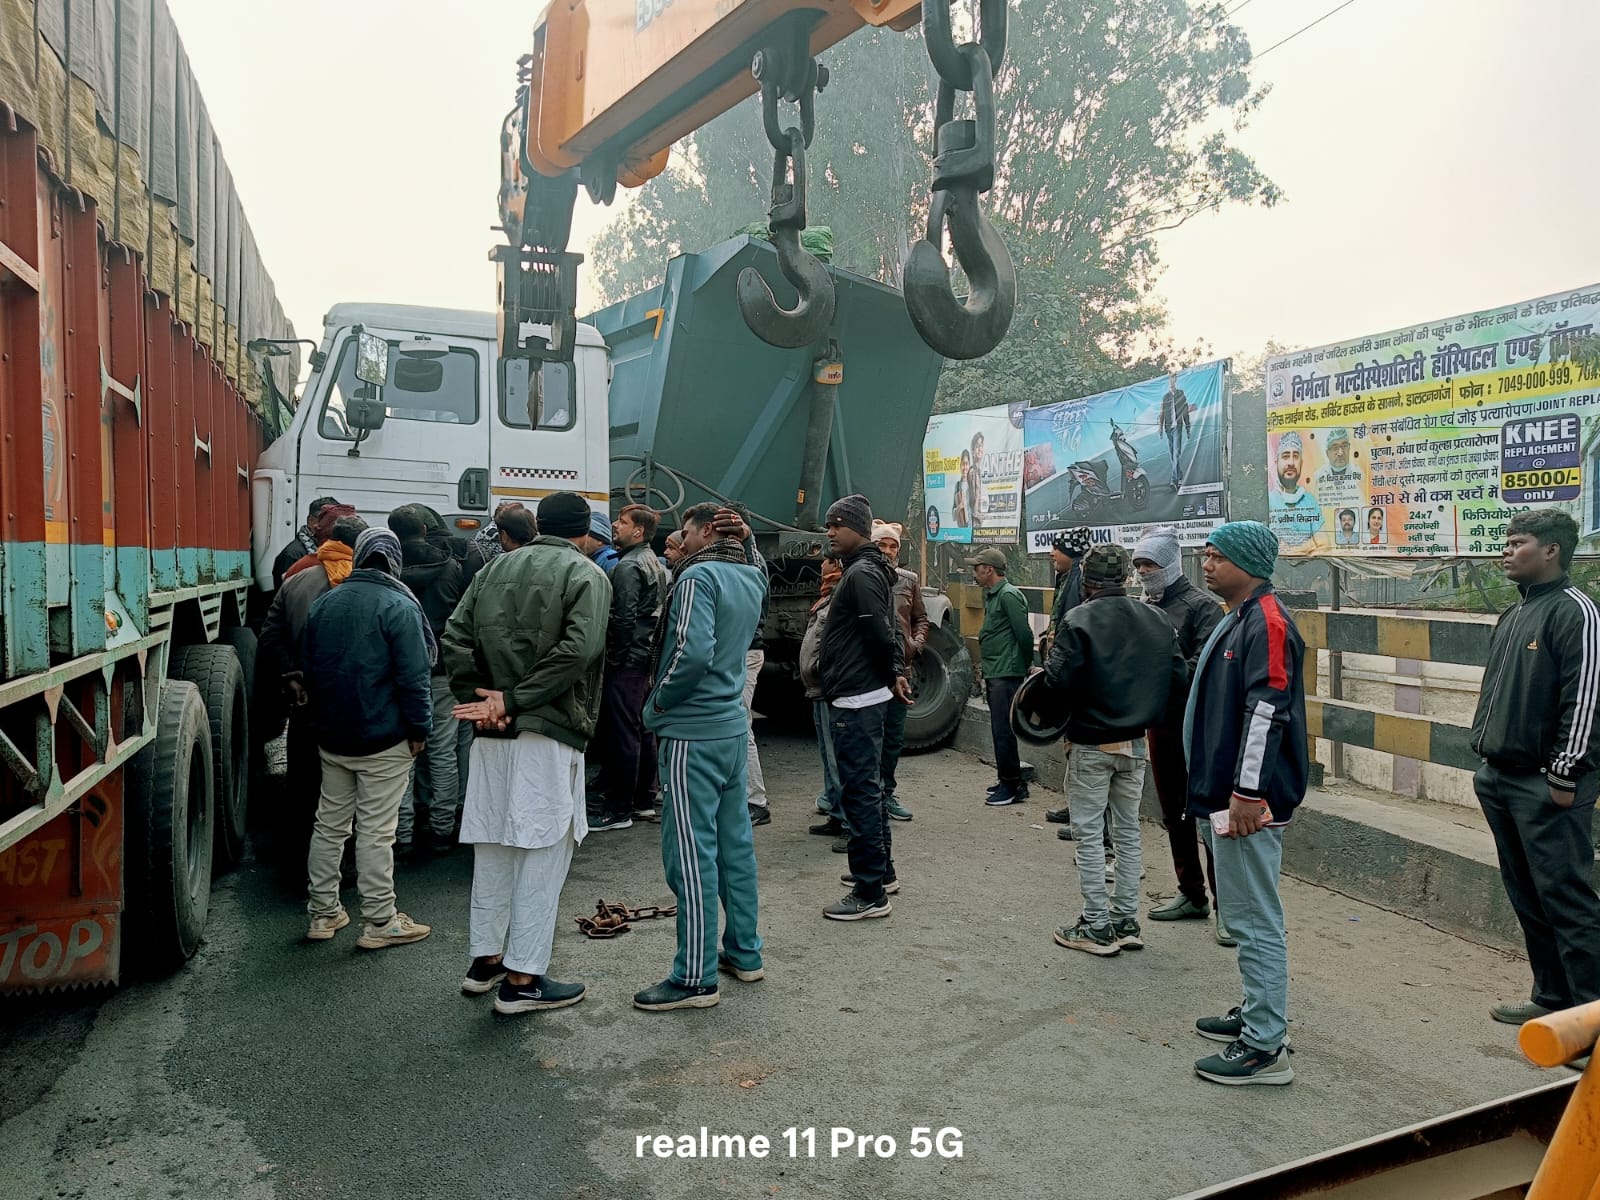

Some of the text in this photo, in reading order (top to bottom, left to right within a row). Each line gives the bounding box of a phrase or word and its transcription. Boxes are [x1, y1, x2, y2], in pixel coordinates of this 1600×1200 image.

[1314, 350, 1325, 363] एवं
[1326, 346, 1348, 360] जटिल
[1349, 339, 1372, 355] सर्जरी
[1373, 339, 1391, 351] आम
[1393, 330, 1415, 346] लोगों
[1416, 327, 1429, 341] की
[1455, 319, 1466, 332] के
[1468, 315, 1495, 329] भीतर
[1496, 307, 1518, 325] लाने
[1520, 304, 1534, 318] के
[1535, 300, 1558, 316] लिए
[1291, 371, 1331, 402] निर्मला
[1334, 350, 1427, 395] मल्टीस्पेशलिटी
[1431, 342, 1499, 378] हॉस्पिटल
[1367, 396, 1376, 412] के
[1459, 381, 1485, 399] फोन
[1390, 416, 1421, 433] संबंधित
[1423, 413, 1438, 428] रोग
[1440, 410, 1454, 426] एवं
[1457, 408, 1477, 426] जोड़
[1505, 417, 1577, 445] KNEE
[1396, 441, 1415, 455] कंधा
[1416, 438, 1428, 453] एवं
[1453, 433, 1499, 451] प्रत्यारोपण
[1504, 442, 1577, 458] REPLACEMENT
[1531, 457, 1546, 469] @
[1450, 469, 1463, 481] की
[1465, 467, 1490, 483] तुलना
[1491, 465, 1499, 479] में
[1504, 470, 1578, 488] 85000/-
[1371, 492, 1395, 506] आधे
[1399, 490, 1411, 504] से
[1414, 487, 1427, 502] भी
[1429, 489, 1454, 502] कम
[1488, 484, 1500, 499] में
[1523, 489, 1555, 501] only
[1409, 510, 1433, 520] 24x7
[1424, 532, 1436, 542] एवं
[1470, 524, 1485, 537] की
[1469, 540, 1482, 552] भी
